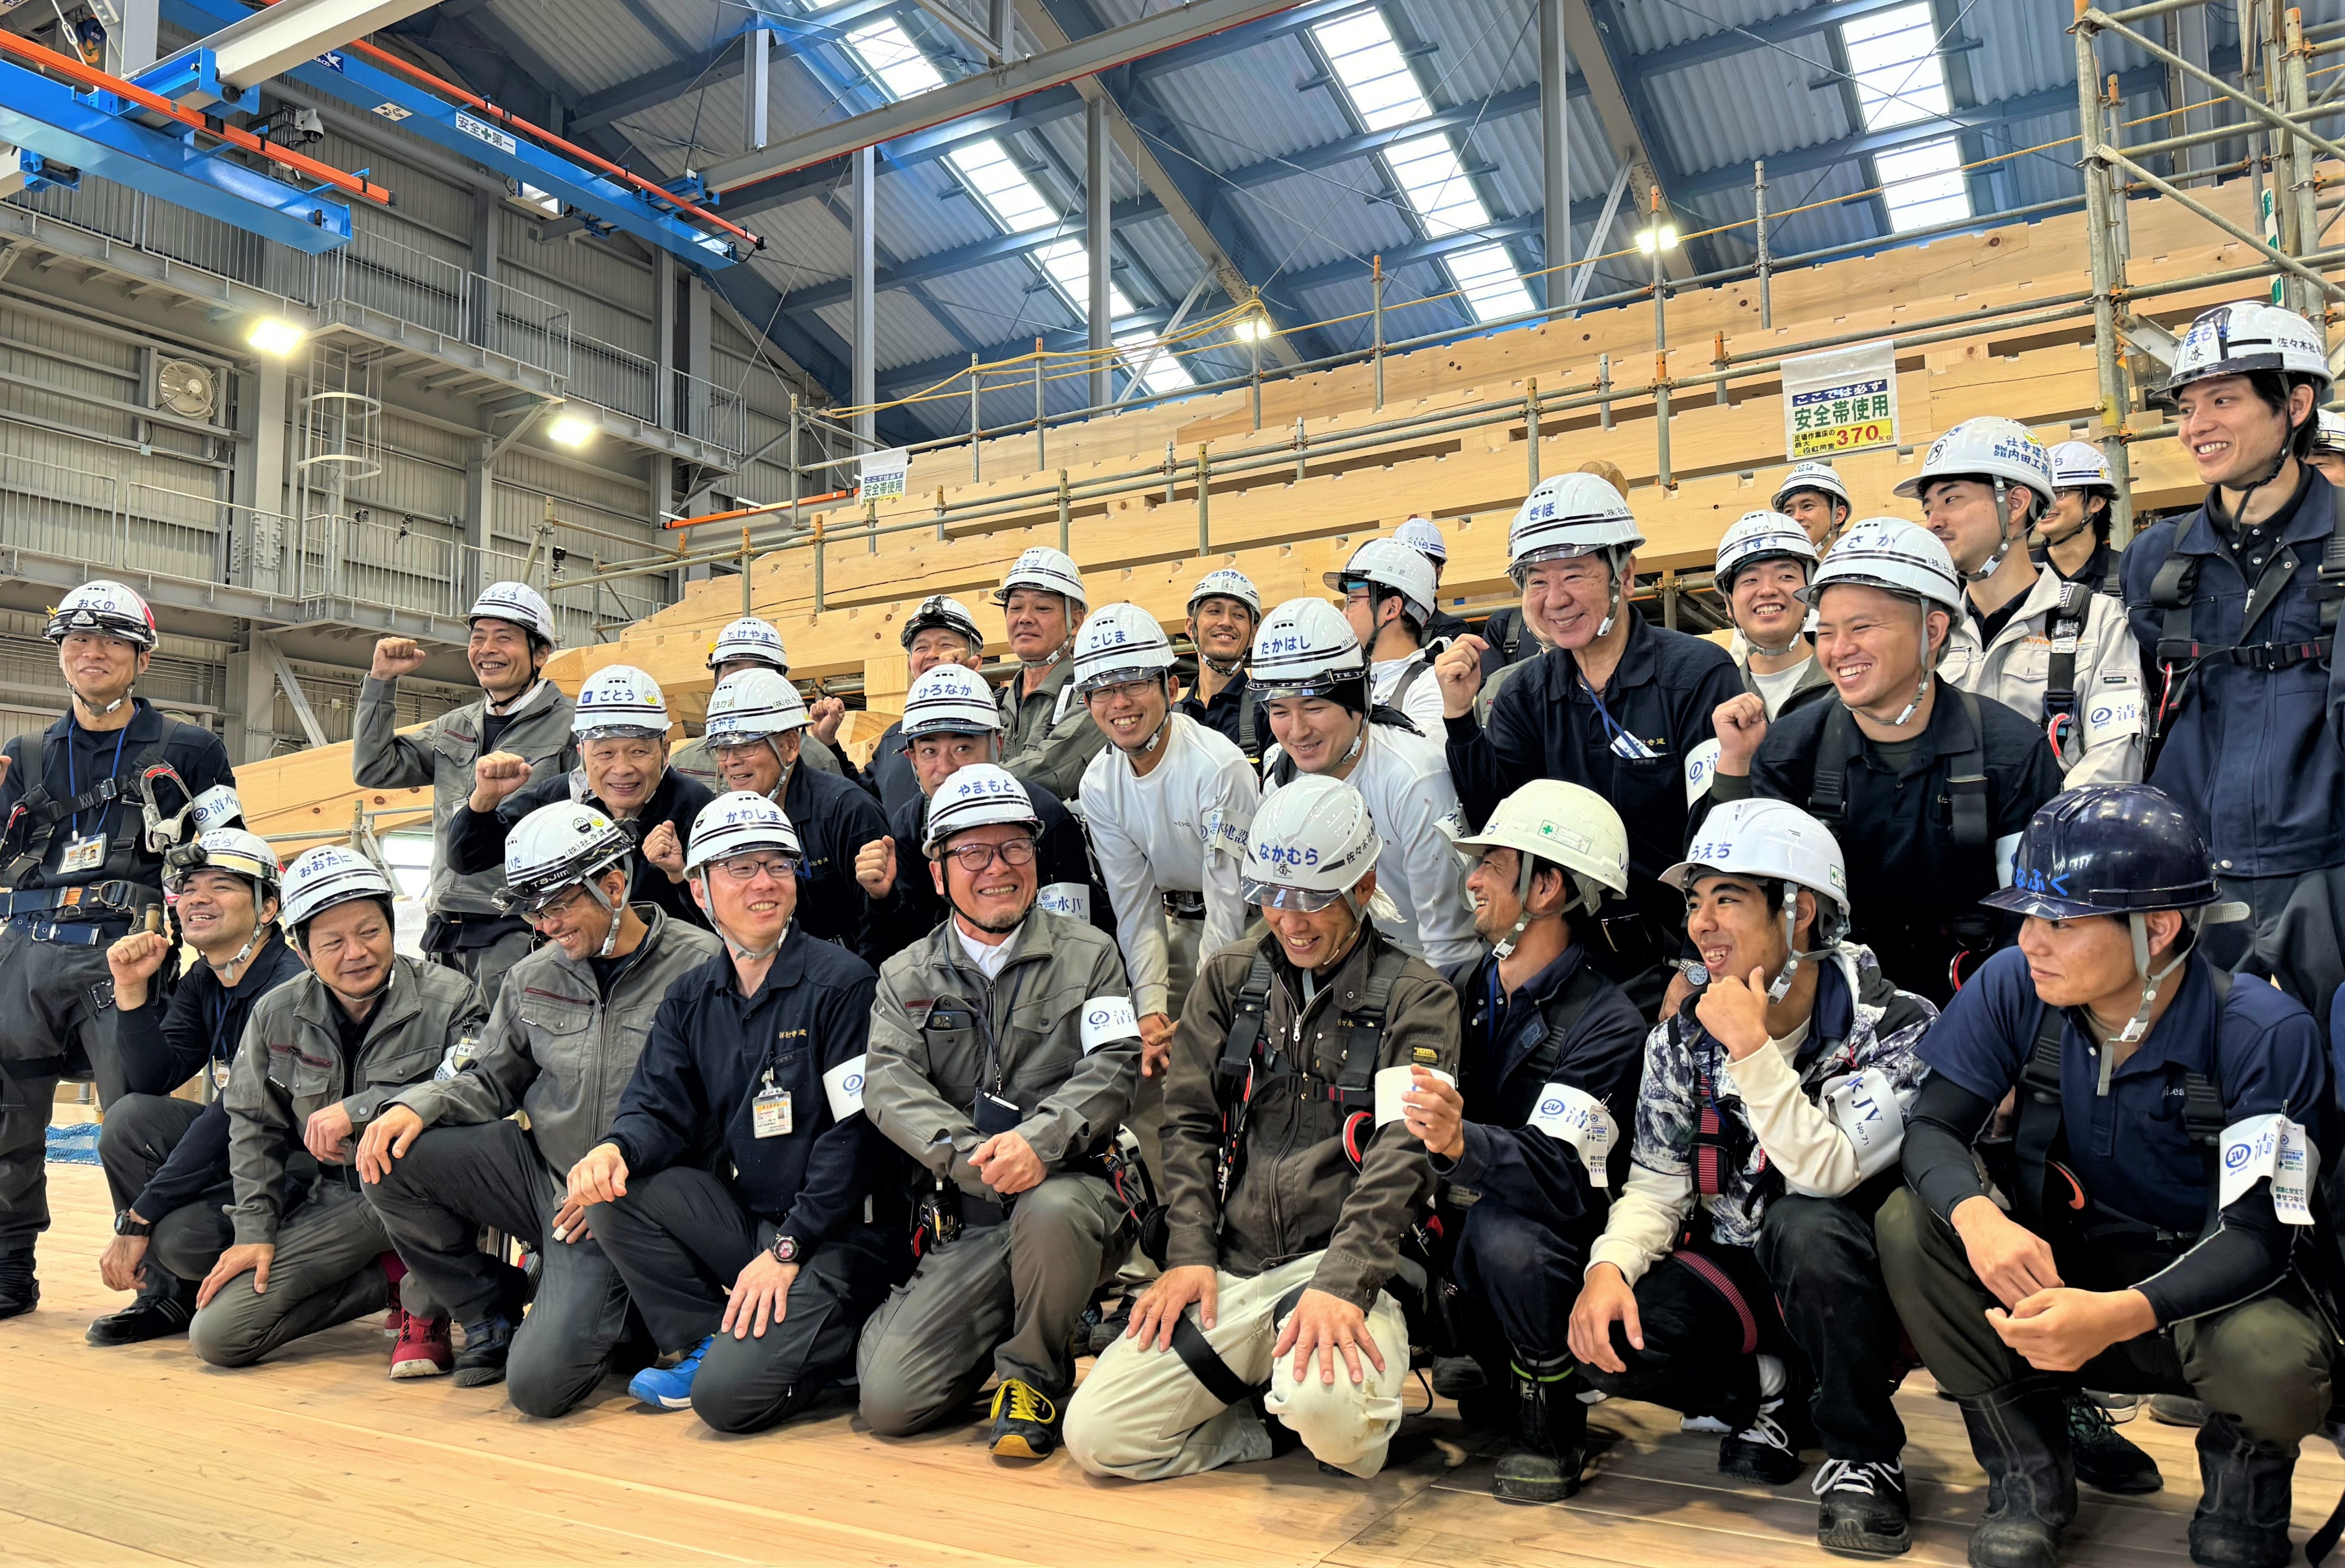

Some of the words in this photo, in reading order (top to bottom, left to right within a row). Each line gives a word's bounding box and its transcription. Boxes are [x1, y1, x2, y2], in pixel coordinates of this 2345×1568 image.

[1797, 381, 1883, 404] ここでは必ず
[1794, 394, 1889, 431] 安全帯使用
[864, 480, 903, 498] 安全帯使用
[77, 598, 116, 611] おくの
[727, 630, 770, 641] たけやま
[1091, 629, 1127, 649] こじま
[1261, 635, 1311, 655] たかはし
[600, 689, 635, 701] ごとう
[918, 683, 972, 699] ひろなか
[958, 779, 1014, 797] やまもと
[726, 808, 780, 824] かわしま
[1259, 842, 1318, 866] なかむら
[1691, 841, 1732, 862] うえち
[299, 854, 353, 878] おおたに
